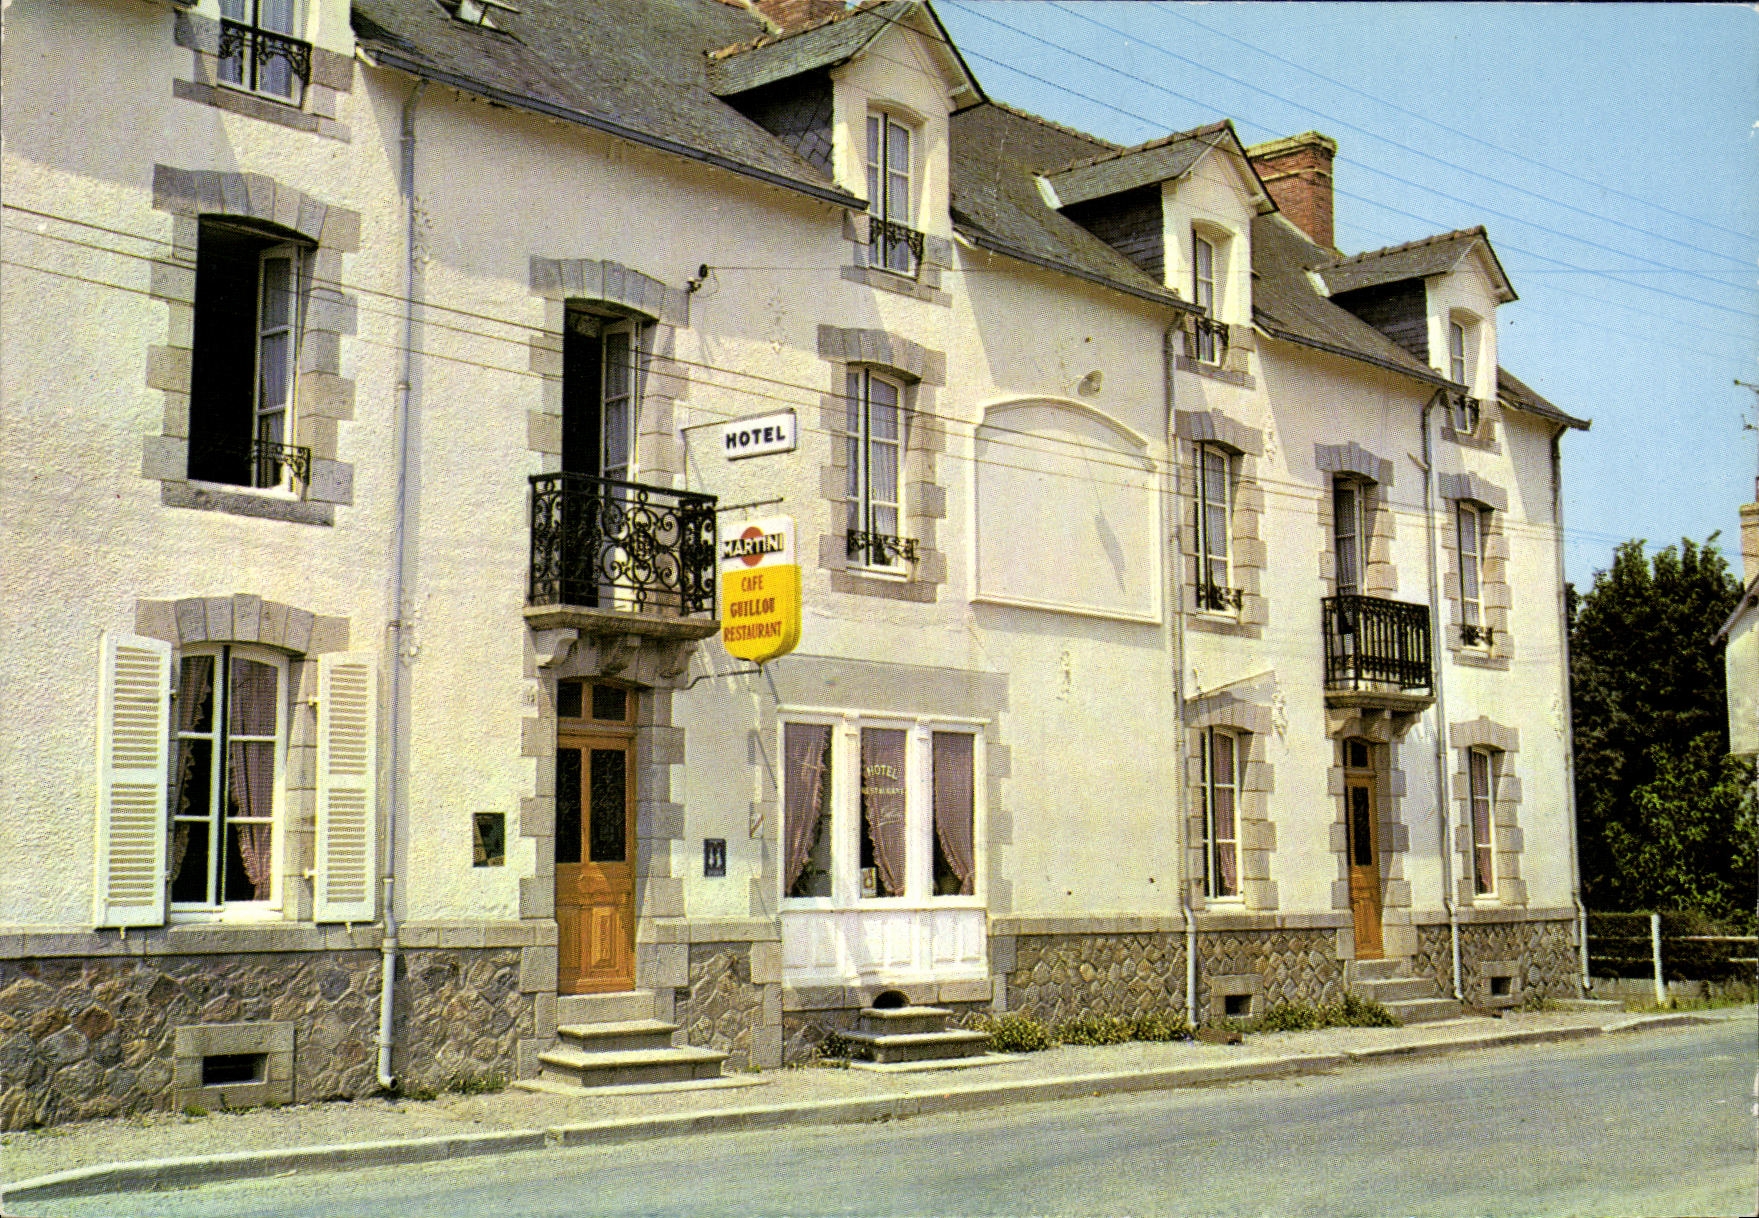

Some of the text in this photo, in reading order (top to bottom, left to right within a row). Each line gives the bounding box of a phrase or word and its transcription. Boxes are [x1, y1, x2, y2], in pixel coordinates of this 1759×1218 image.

[726, 425, 786, 449] HOTEL
[721, 532, 784, 559] MARTINI
[741, 574, 764, 592] CAFE
[723, 621, 782, 642] RESTAURANT
[866, 764, 898, 780] HOTEL
